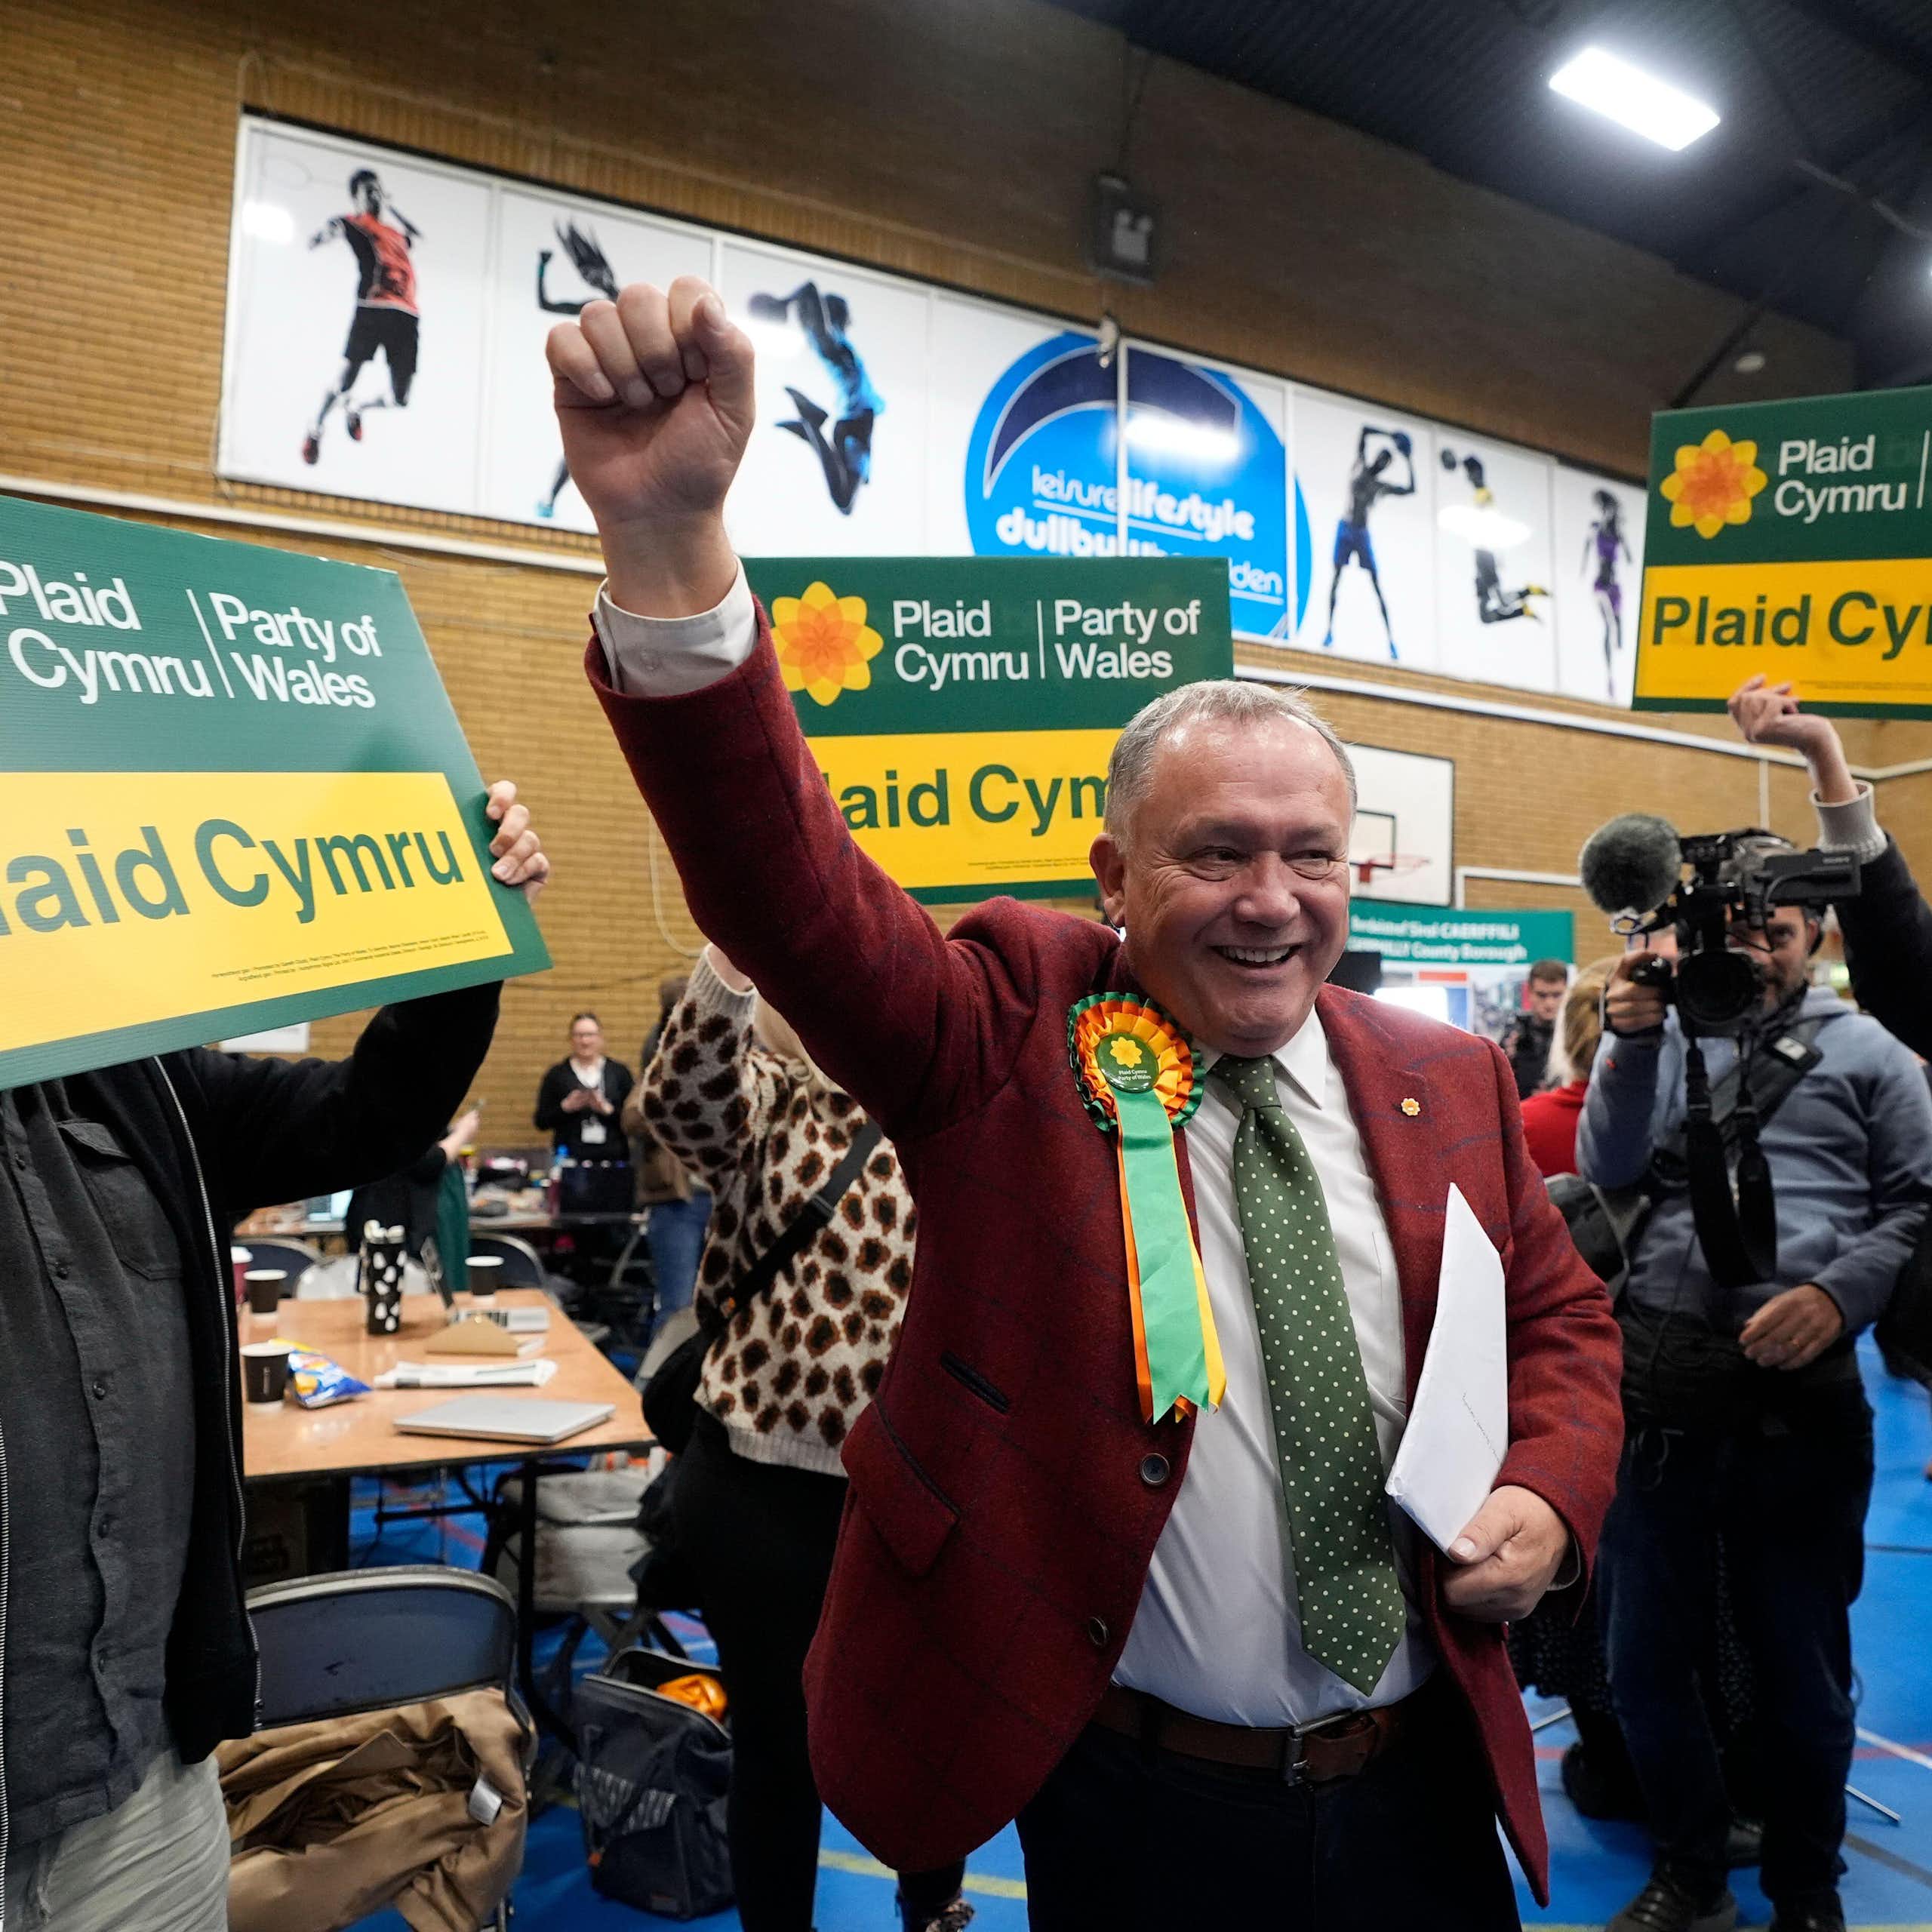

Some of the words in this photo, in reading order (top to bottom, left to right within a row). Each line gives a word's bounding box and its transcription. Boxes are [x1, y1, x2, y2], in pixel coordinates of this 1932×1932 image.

[1779, 434, 1876, 476] Plaid
[1774, 480, 1908, 524] Cymru
[0, 561, 142, 631] Plaid
[893, 600, 992, 638] Plaid
[1055, 599, 1158, 644] Party
[1164, 600, 1201, 636] of
[209, 592, 333, 663] Party
[341, 614, 383, 657] of
[1652, 593, 1811, 648] Plaid
[1828, 591, 1932, 661] Cy
[8, 627, 216, 705] Cymru
[229, 651, 377, 709] Wales
[894, 643, 1029, 691] Cymru
[1055, 642, 1173, 679] Wales
[822, 768, 950, 830] aid
[0, 826, 191, 937] aid
[194, 818, 465, 924] Cymru
